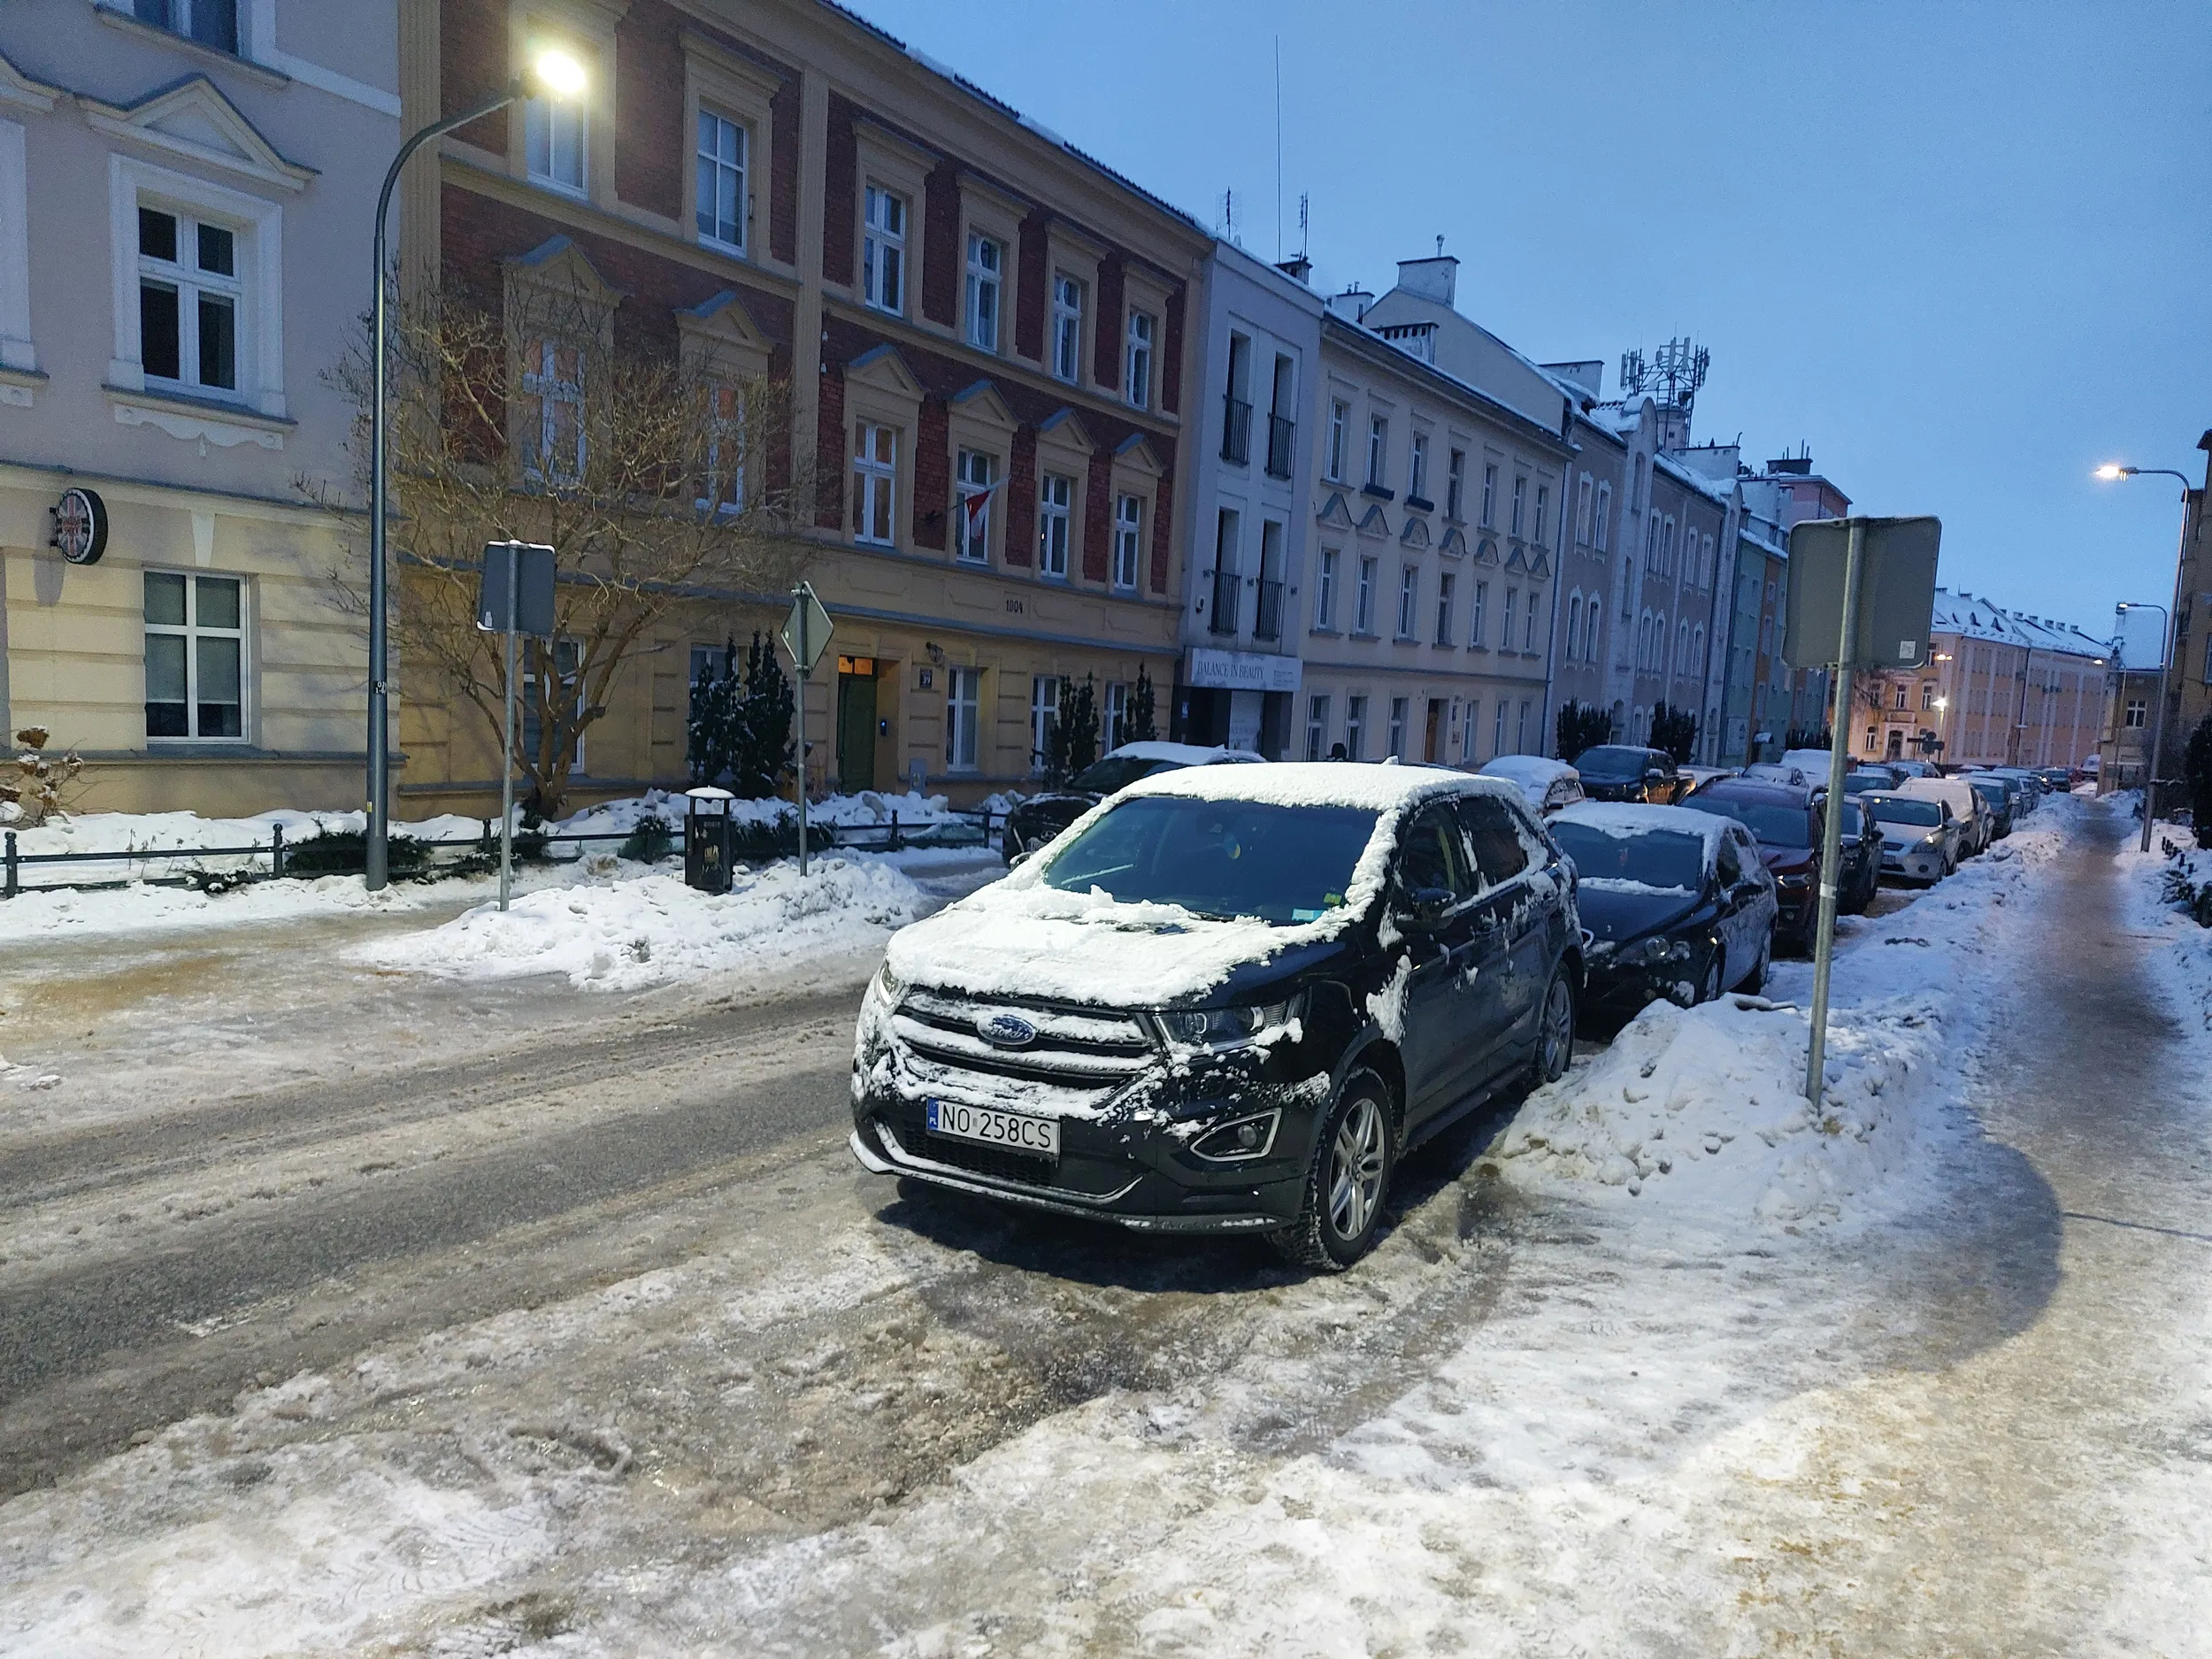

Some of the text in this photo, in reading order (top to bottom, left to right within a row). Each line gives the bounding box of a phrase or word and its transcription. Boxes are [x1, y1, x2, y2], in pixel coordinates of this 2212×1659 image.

[1197, 660, 1228, 677] BALANCE
[1230, 664, 1238, 678] IN
[1239, 664, 1263, 680] BEAUTY
[929, 1117, 937, 1125] PL
[942, 1104, 1050, 1148] NO 258CS
